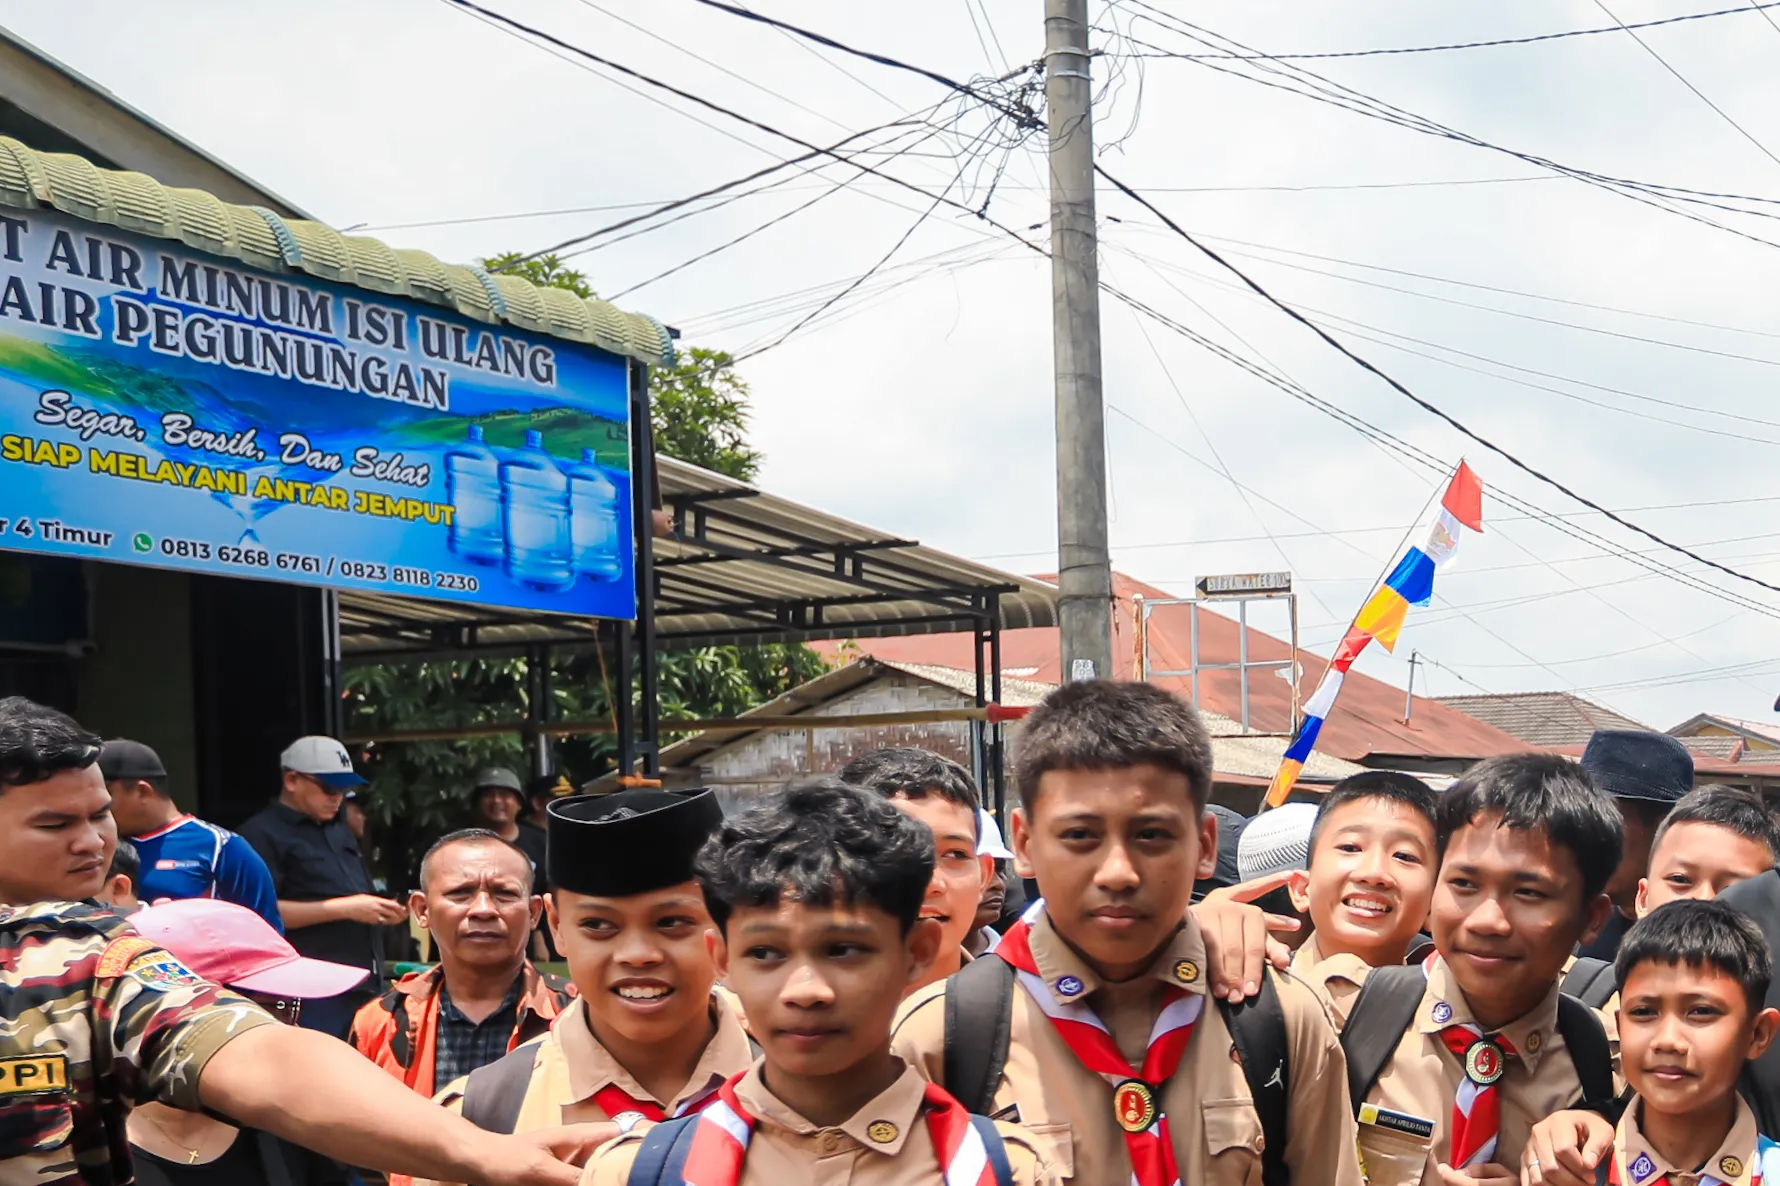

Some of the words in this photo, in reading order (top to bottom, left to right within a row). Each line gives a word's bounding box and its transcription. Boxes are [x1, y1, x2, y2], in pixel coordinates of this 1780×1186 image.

[0, 275, 99, 336] AIR
[114, 298, 447, 408] PEGUNUNGAN
[45, 229, 144, 292] AIR
[159, 255, 333, 335] MINUM
[346, 299, 406, 351] ISI
[418, 317, 555, 386] ULANG
[1, 434, 82, 468] SIAP
[88, 447, 247, 496] MELAYANI
[253, 475, 349, 512] ANTAR
[353, 490, 456, 527] JEMPUT
[35, 390, 147, 442] Segar,
[162, 412, 266, 462] Bersih,
[279, 433, 342, 473] Dan
[350, 446, 430, 487] Sehat
[15, 518, 33, 537] 4
[38, 520, 113, 546] Timur
[160, 538, 211, 560] 0813
[217, 545, 270, 568] 6268
[276, 552, 320, 574] 6761
[340, 560, 387, 581] 0823
[392, 567, 431, 587] 8118
[435, 573, 479, 592] 2230
[1241, 574, 1271, 588] WATER
[0, 1063, 54, 1087] PI
